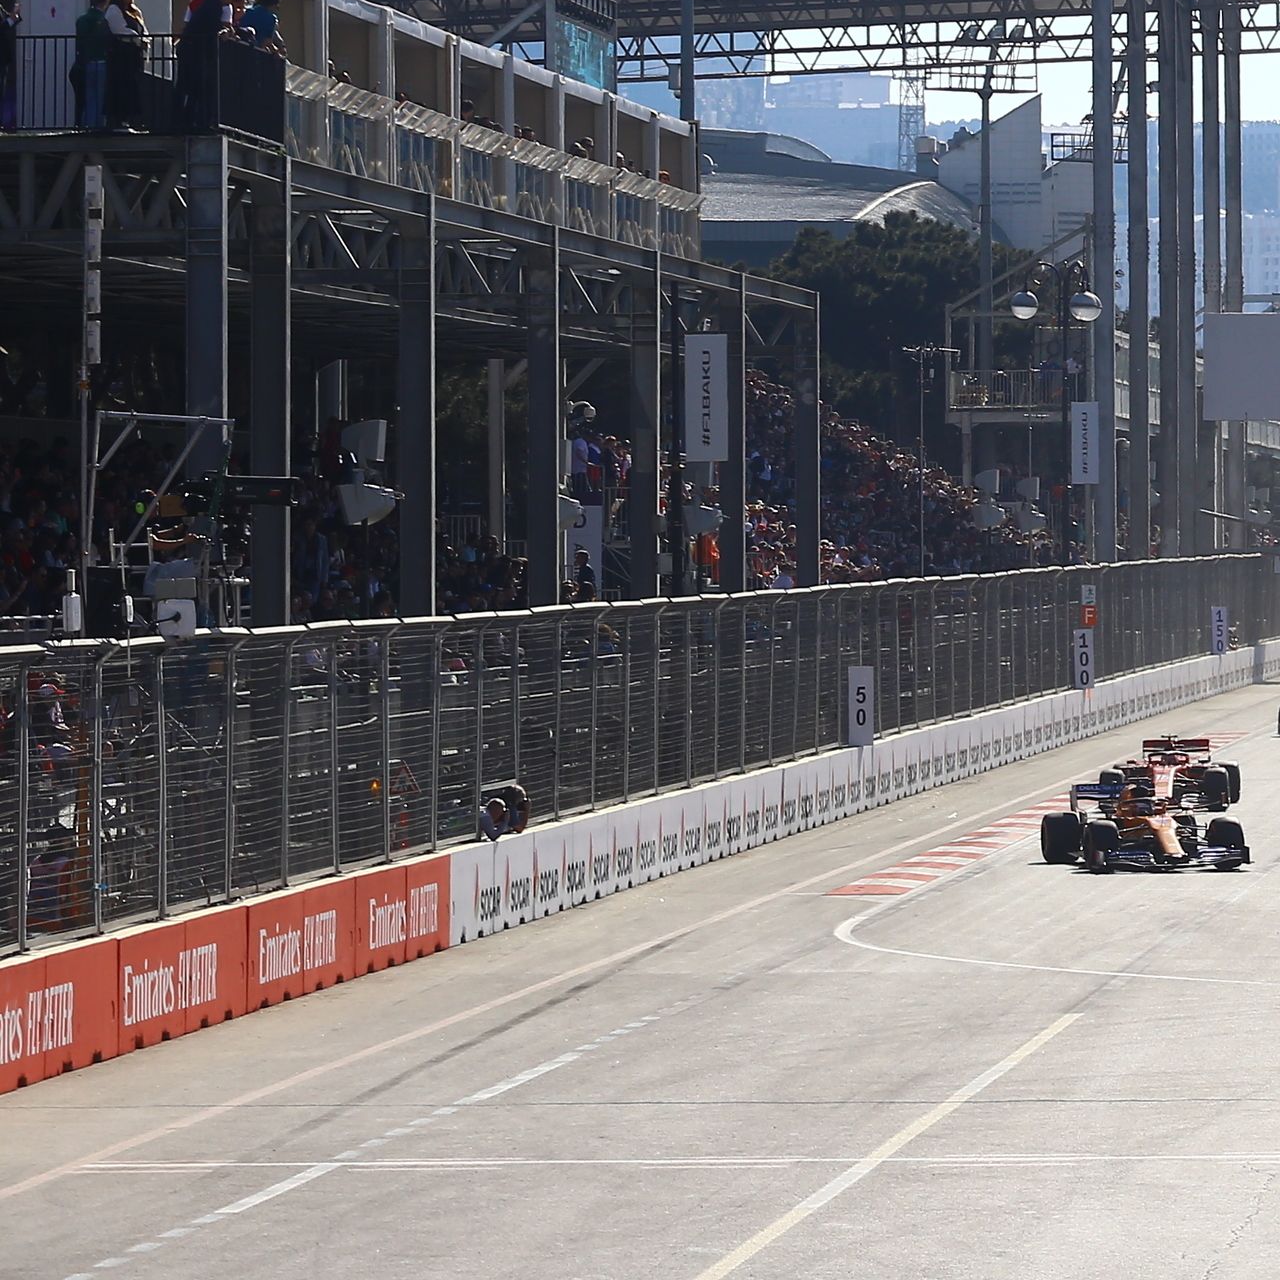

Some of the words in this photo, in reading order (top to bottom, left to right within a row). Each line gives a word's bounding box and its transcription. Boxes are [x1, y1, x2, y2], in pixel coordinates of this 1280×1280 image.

[702, 350, 711, 446] #F1BAKU
[1085, 608, 1095, 624] F
[567, 861, 586, 893] SOCAR
[593, 853, 610, 885] SOCAR
[617, 846, 633, 877] SOCAR
[510, 877, 530, 912] SOCAR
[540, 869, 559, 902] SOCAR
[369, 894, 407, 950] Emirates
[409, 888, 419, 939] FLY
[418, 882, 439, 936] BETTER
[480, 886, 501, 921] SOCAR
[259, 923, 302, 984] Emirates
[303, 915, 316, 971] FLY
[316, 909, 337, 966] BETTER
[124, 959, 175, 1026] Emirates
[178, 949, 192, 1011] FLY
[191, 942, 218, 1007] BETTER
[26, 991, 42, 1058] FLY
[43, 981, 75, 1051] BETTER
